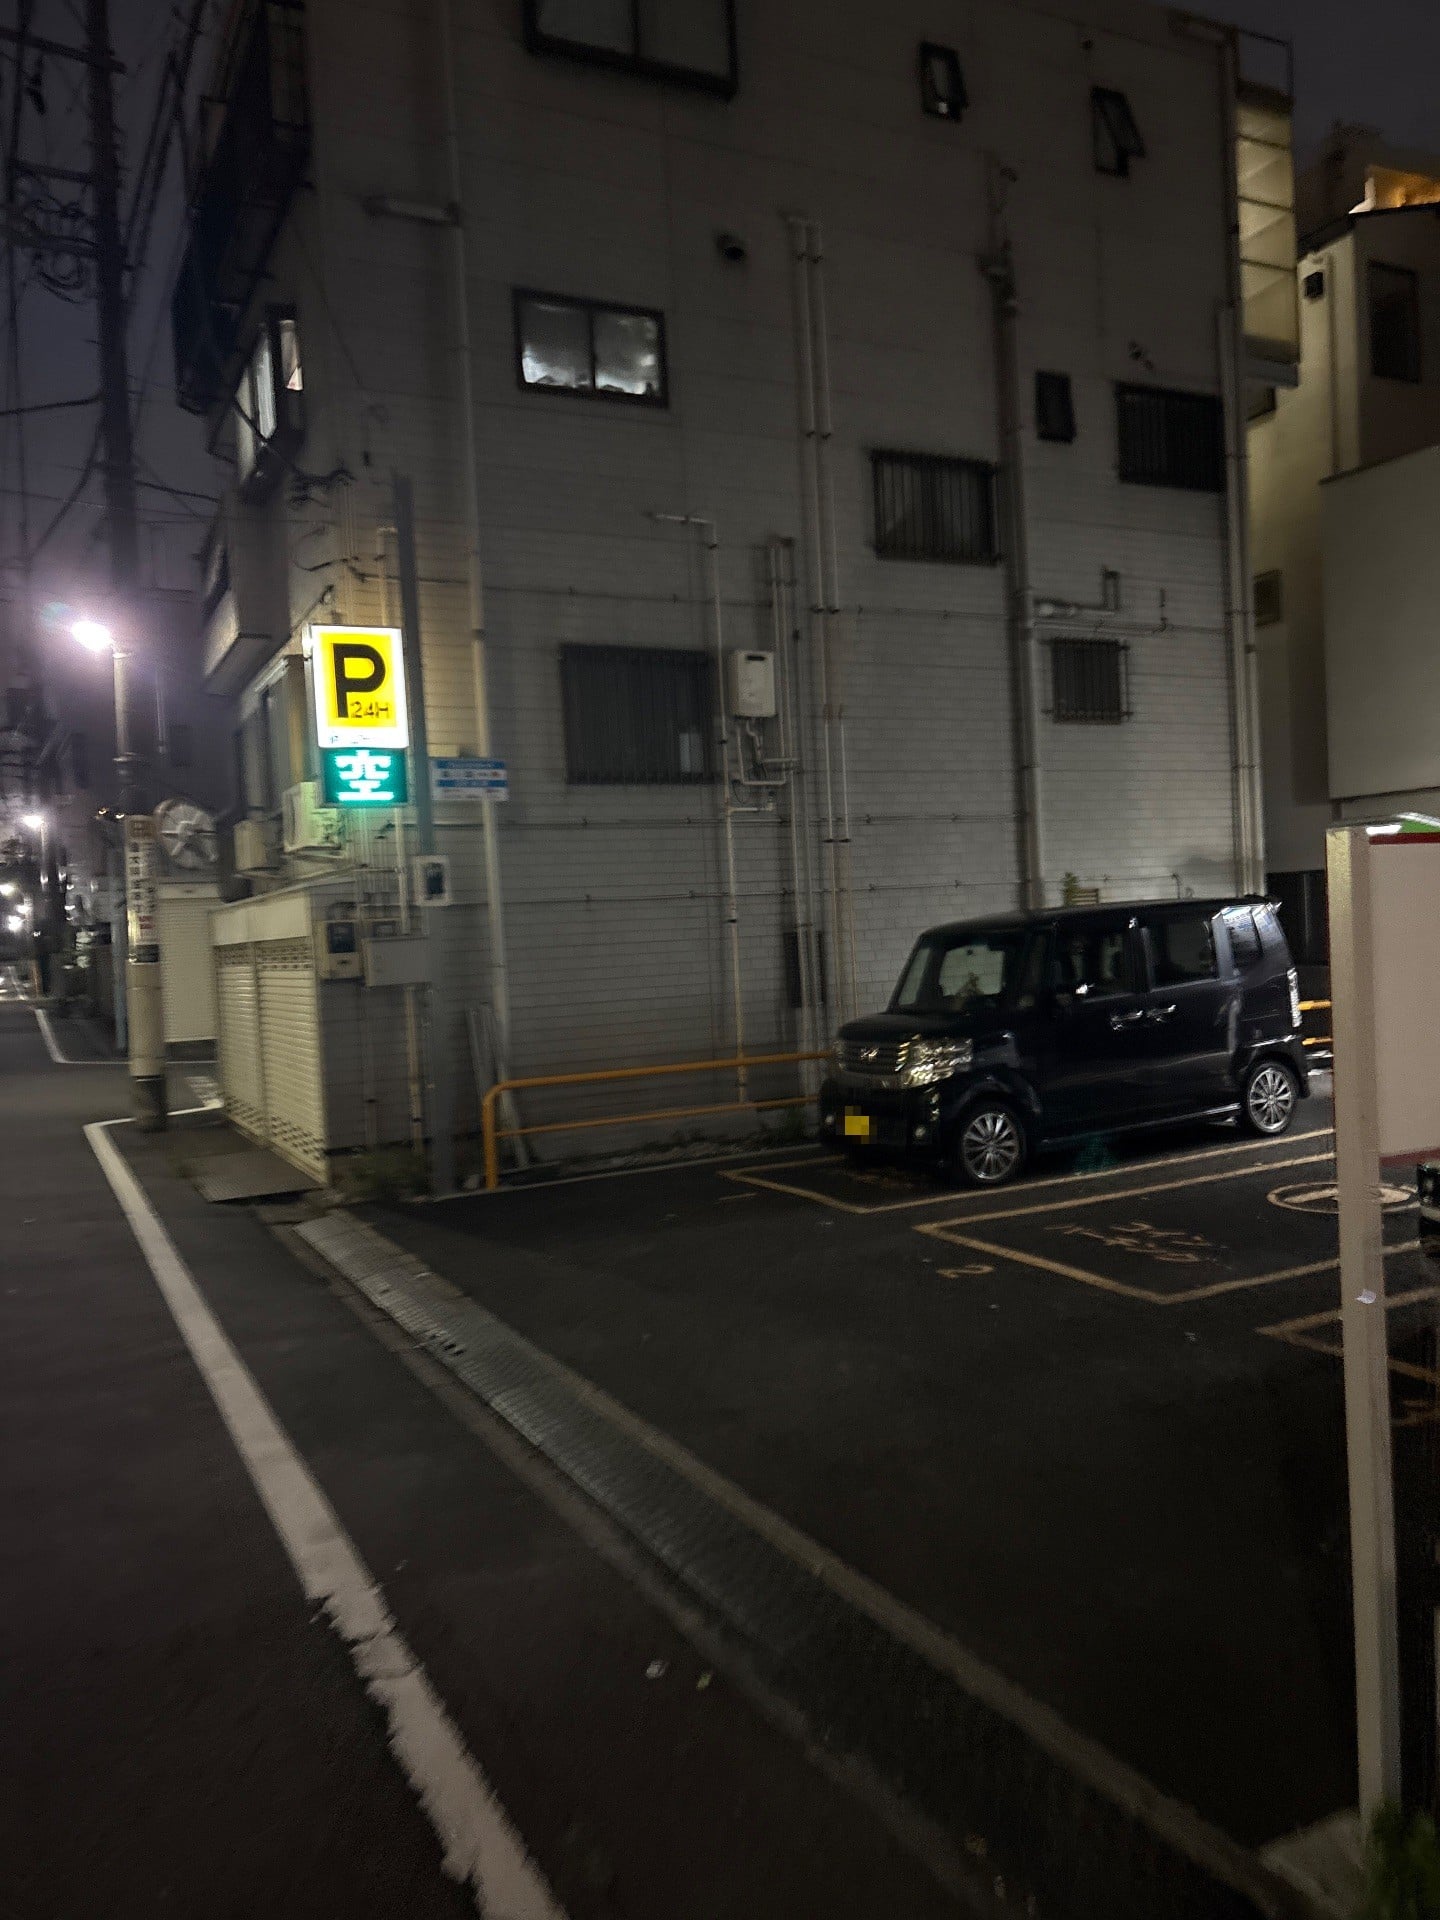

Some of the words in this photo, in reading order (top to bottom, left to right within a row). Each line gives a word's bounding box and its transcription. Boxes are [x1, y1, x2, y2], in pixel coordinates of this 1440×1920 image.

[332, 642, 386, 718] P
[350, 701, 390, 719] 24H
[334, 749, 395, 801] 空
[935, 1263, 994, 1279] 2
